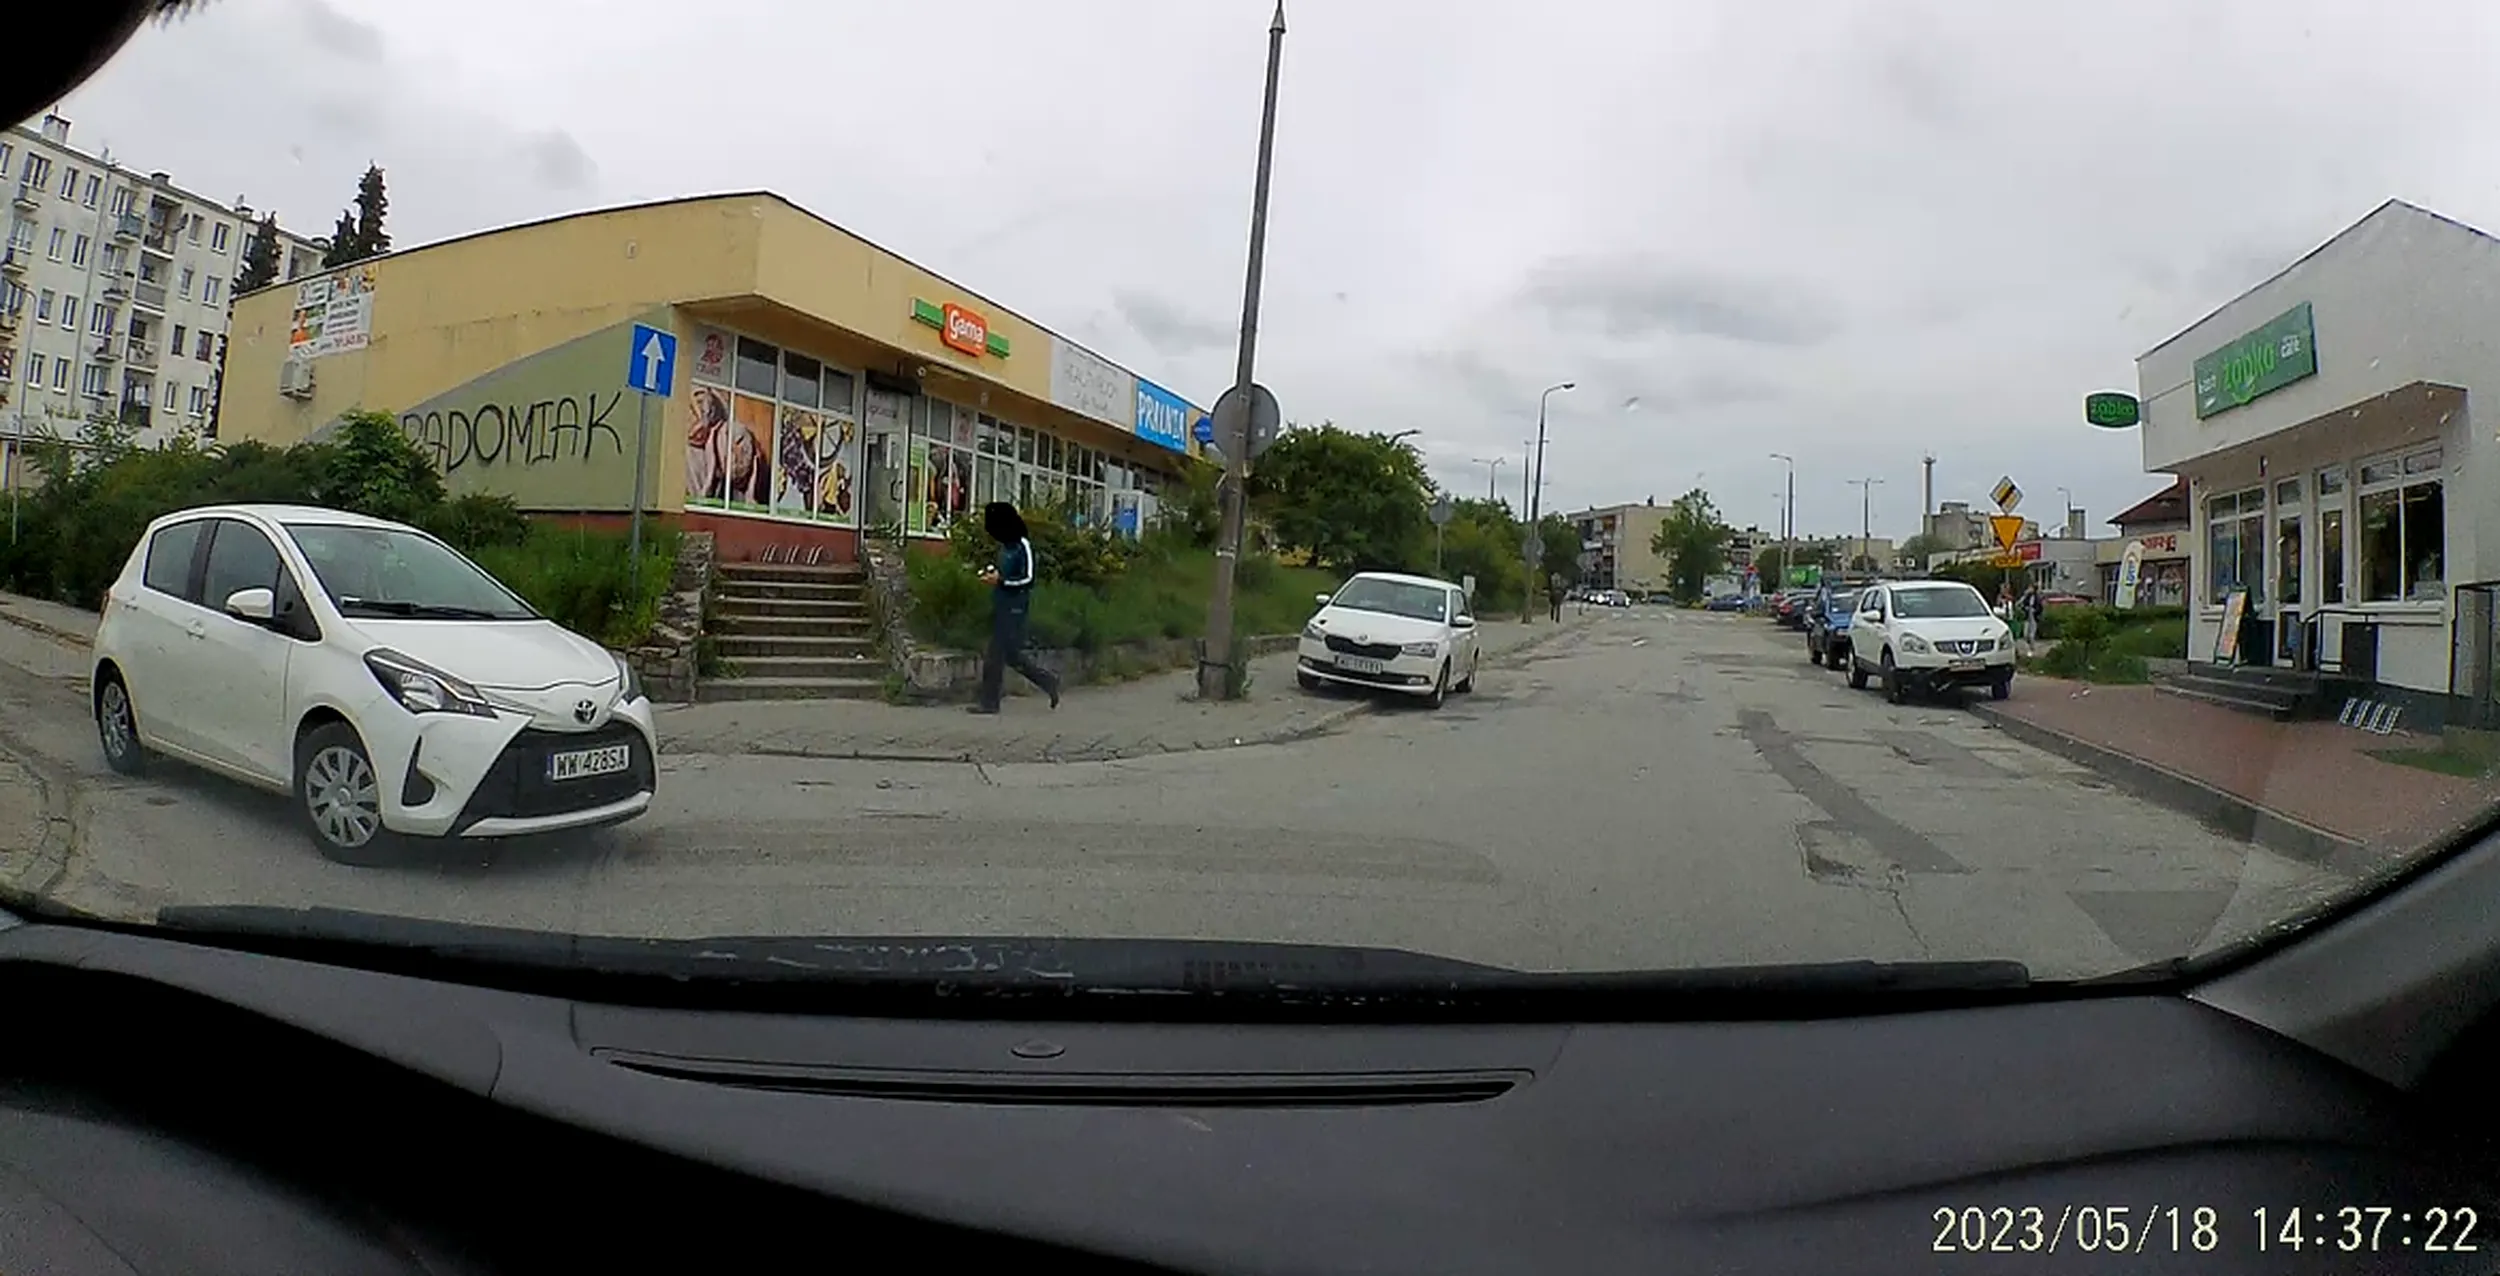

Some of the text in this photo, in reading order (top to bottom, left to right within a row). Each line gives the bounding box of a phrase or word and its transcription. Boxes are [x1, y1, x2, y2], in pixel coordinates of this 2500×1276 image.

[950, 309, 984, 345] Gama
[402, 391, 623, 473] RADOMIAK
[1137, 390, 1185, 441] PRALNIA
[583, 747, 626, 773] 428SA
